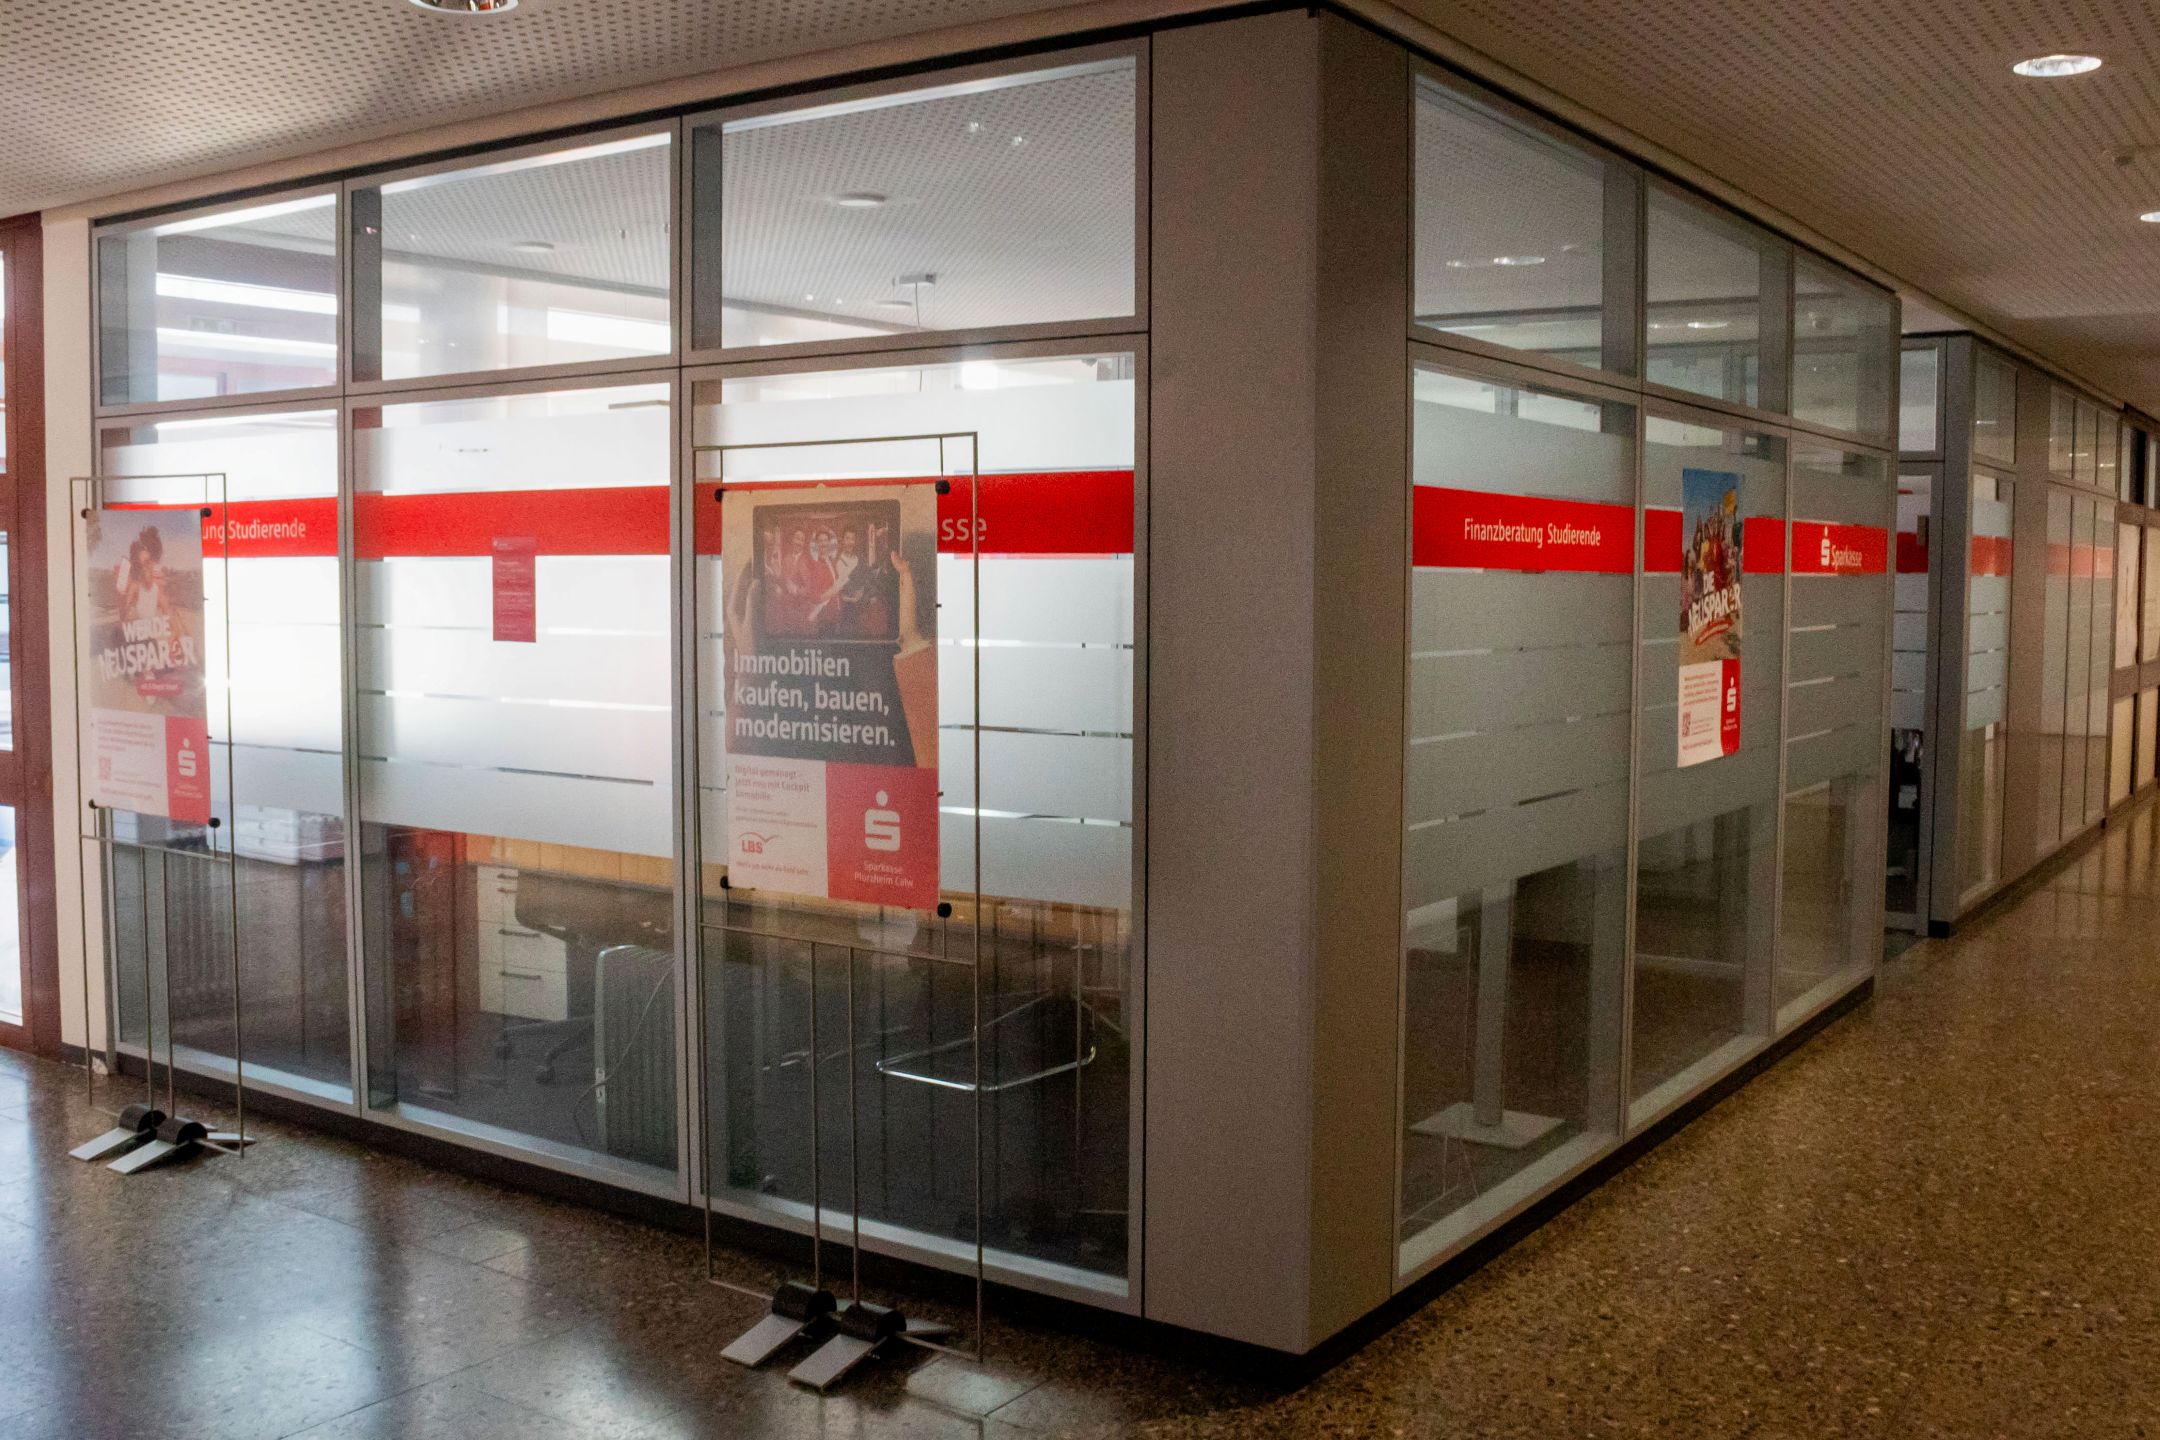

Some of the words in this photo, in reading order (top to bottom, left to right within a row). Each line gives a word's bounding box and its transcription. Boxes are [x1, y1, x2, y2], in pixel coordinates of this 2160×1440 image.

[228, 518, 306, 539] Studierende
[1464, 518, 1543, 549] Finanzberatung
[1547, 522, 1601, 546] Studierende
[1831, 545, 1863, 571] Sparkasse
[121, 614, 172, 642] WERDE
[733, 648, 850, 677] Immobilien
[733, 679, 809, 712] kaufen,
[815, 681, 890, 716] bauen,
[735, 712, 896, 747] modernisieren.
[742, 839, 763, 855] LBS
